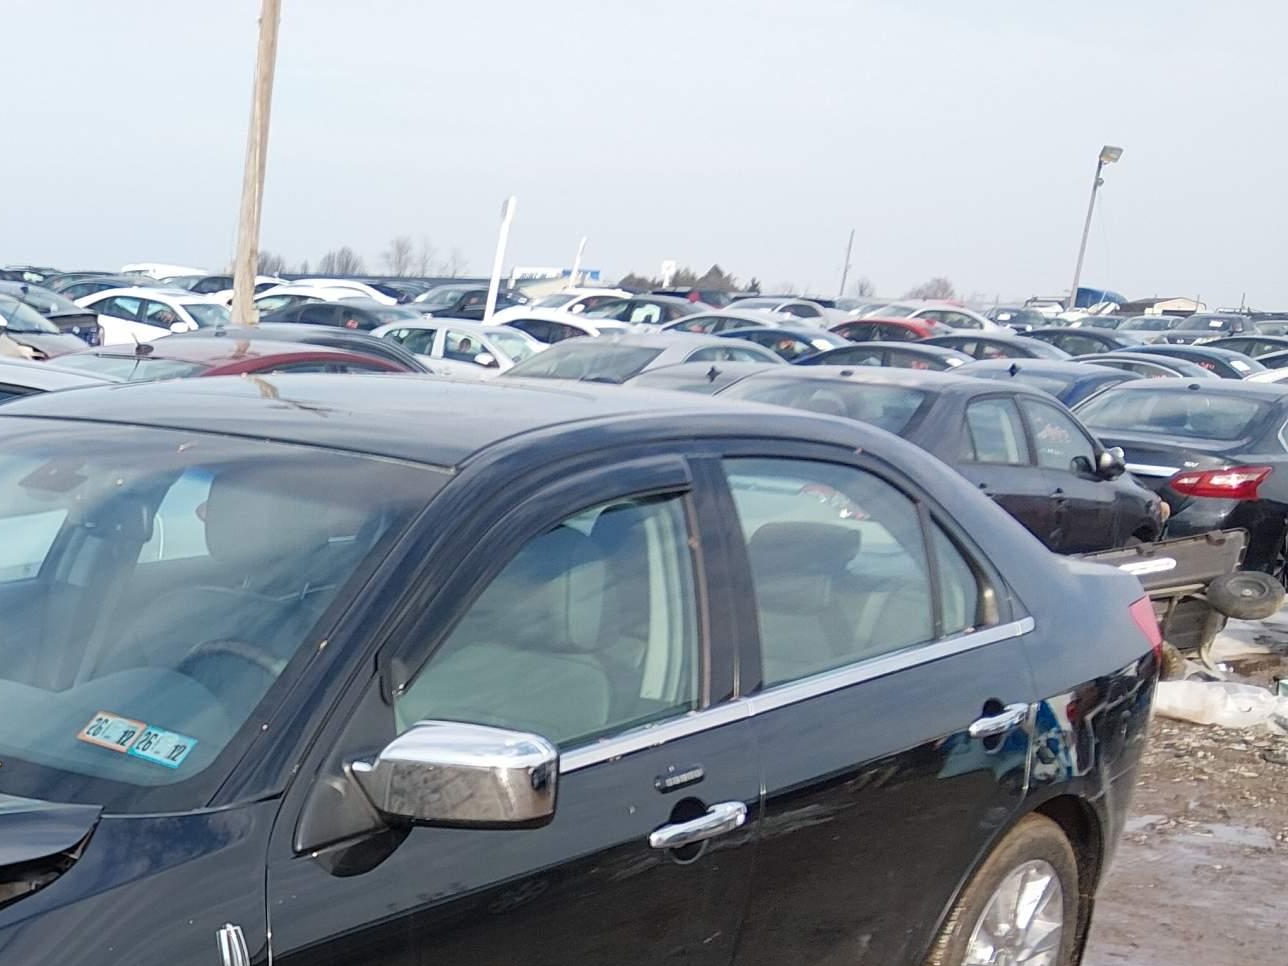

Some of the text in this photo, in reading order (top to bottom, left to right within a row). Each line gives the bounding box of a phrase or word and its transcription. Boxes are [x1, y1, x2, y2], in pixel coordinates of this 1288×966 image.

[86, 717, 136, 746] 26 12
[136, 731, 187, 761] 26 12
